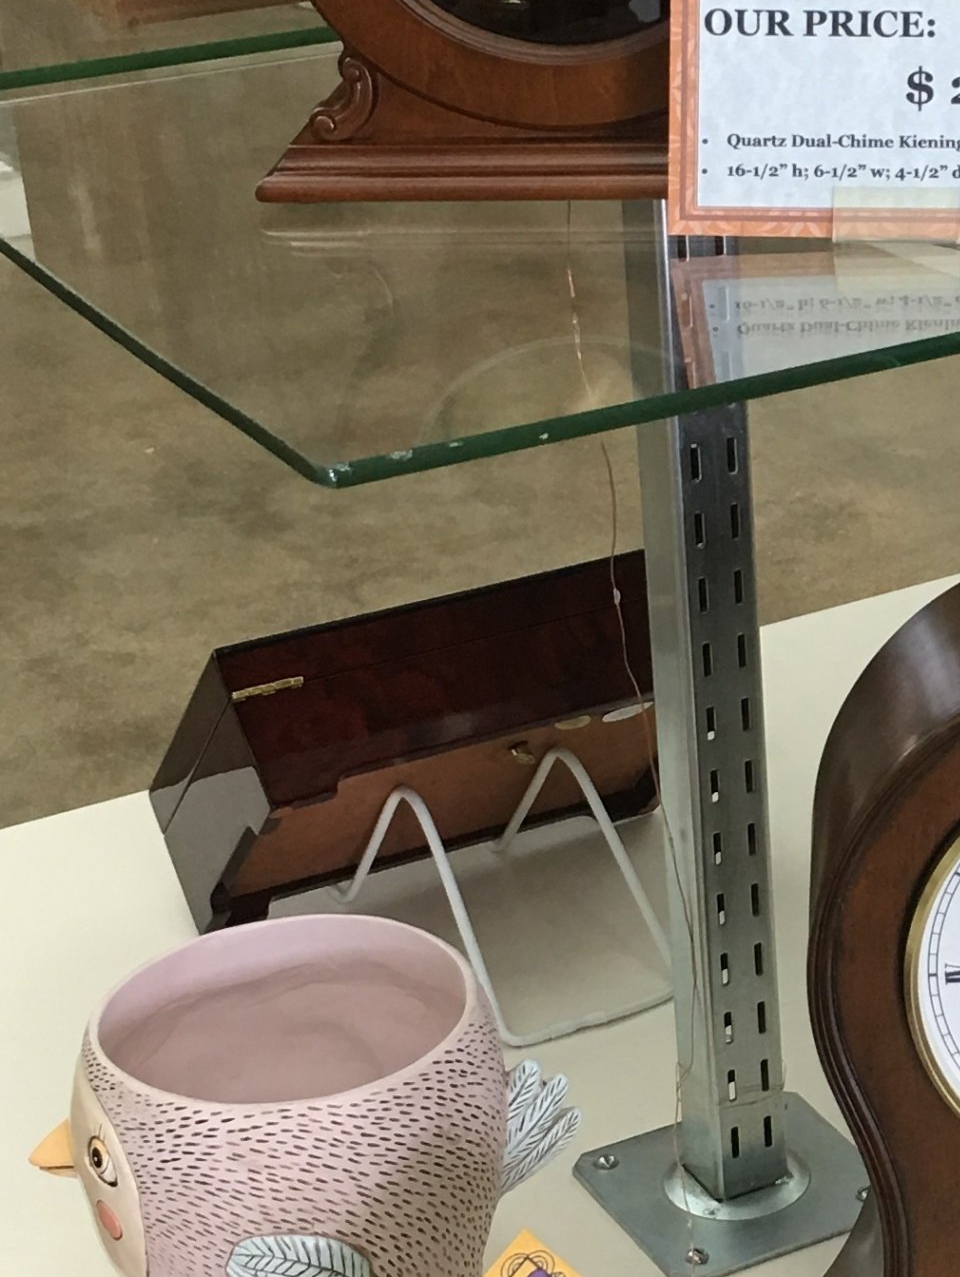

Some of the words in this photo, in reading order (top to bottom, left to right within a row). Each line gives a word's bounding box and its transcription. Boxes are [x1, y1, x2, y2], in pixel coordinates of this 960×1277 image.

[704, 8, 794, 37] OUR
[802, 9, 937, 38] PRICE:
[905, 66, 934, 111] $
[727, 133, 787, 151] Quartz
[791, 134, 894, 150] Dual-Chime
[792, 164, 809, 180] h;
[870, 167, 891, 181] w;
